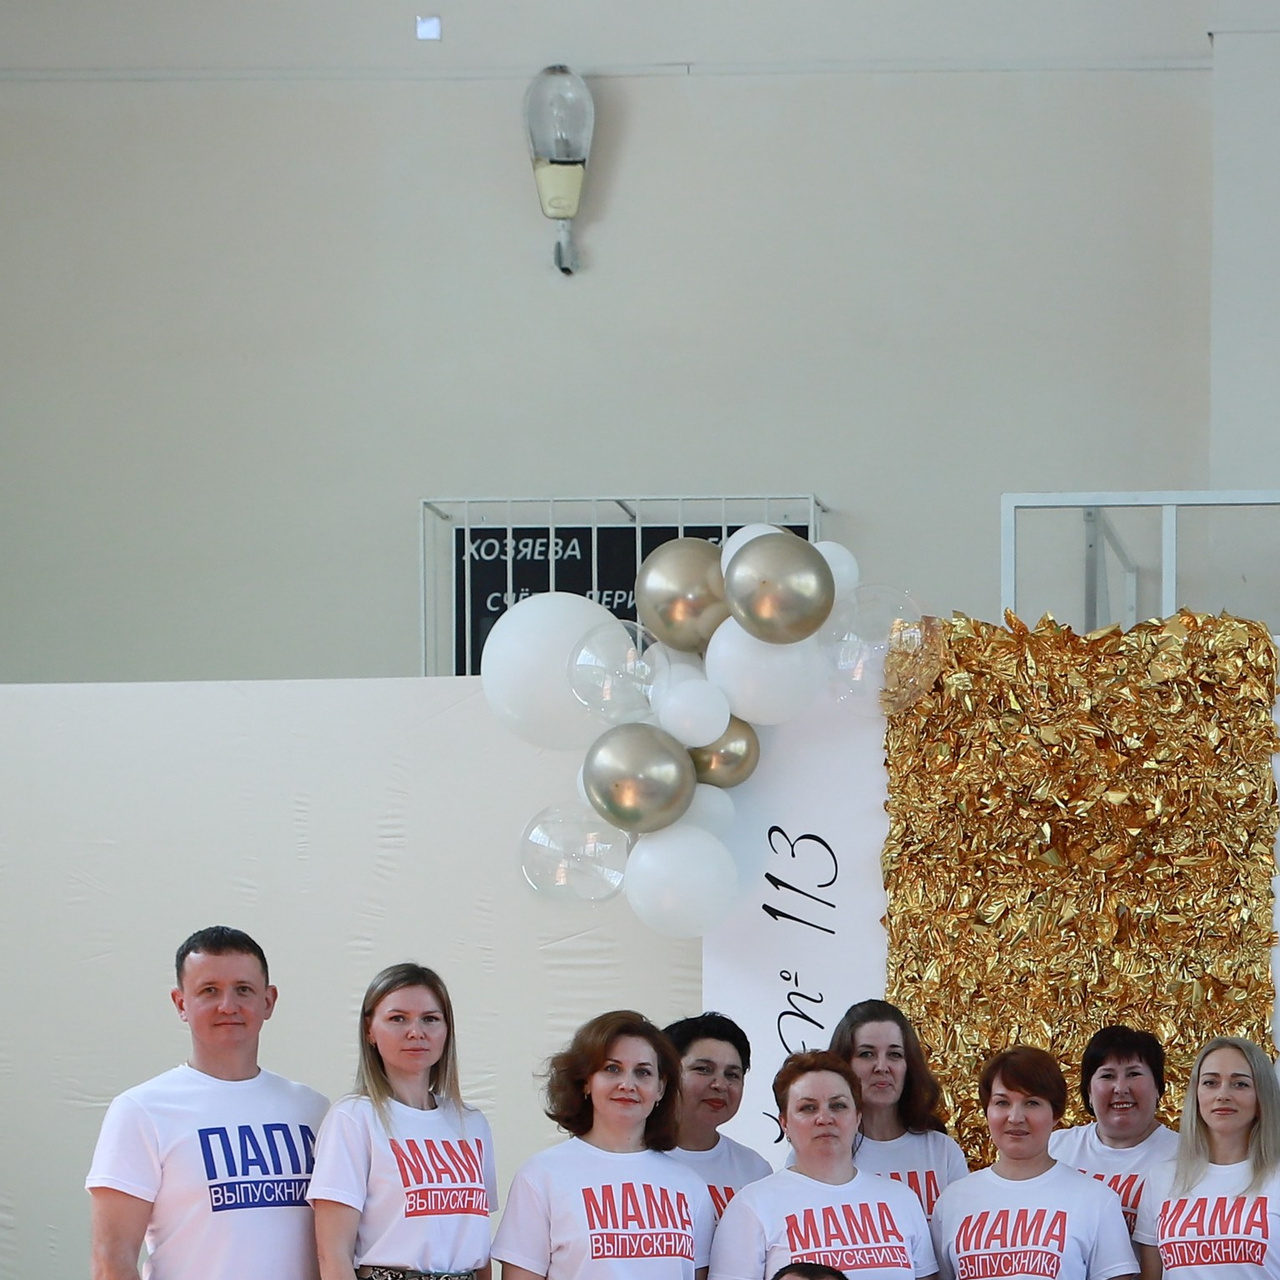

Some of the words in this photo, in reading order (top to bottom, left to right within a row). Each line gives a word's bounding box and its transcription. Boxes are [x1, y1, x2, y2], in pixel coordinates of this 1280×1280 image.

[761, 825, 839, 935] 113
[389, 1138, 484, 1188] МАМ
[210, 1182, 311, 1206] ВЫПУСКНИ
[785, 1202, 904, 1253] МАМА
[956, 1209, 1067, 1254] МАМА
[1158, 1197, 1269, 1240] МАМА
[592, 1233, 695, 1257] ВЫПУСКНИК
[959, 1251, 1057, 1279] ВЫПУСКНИКА
[1160, 1241, 1261, 1267] ВЫПУСКНИКА
